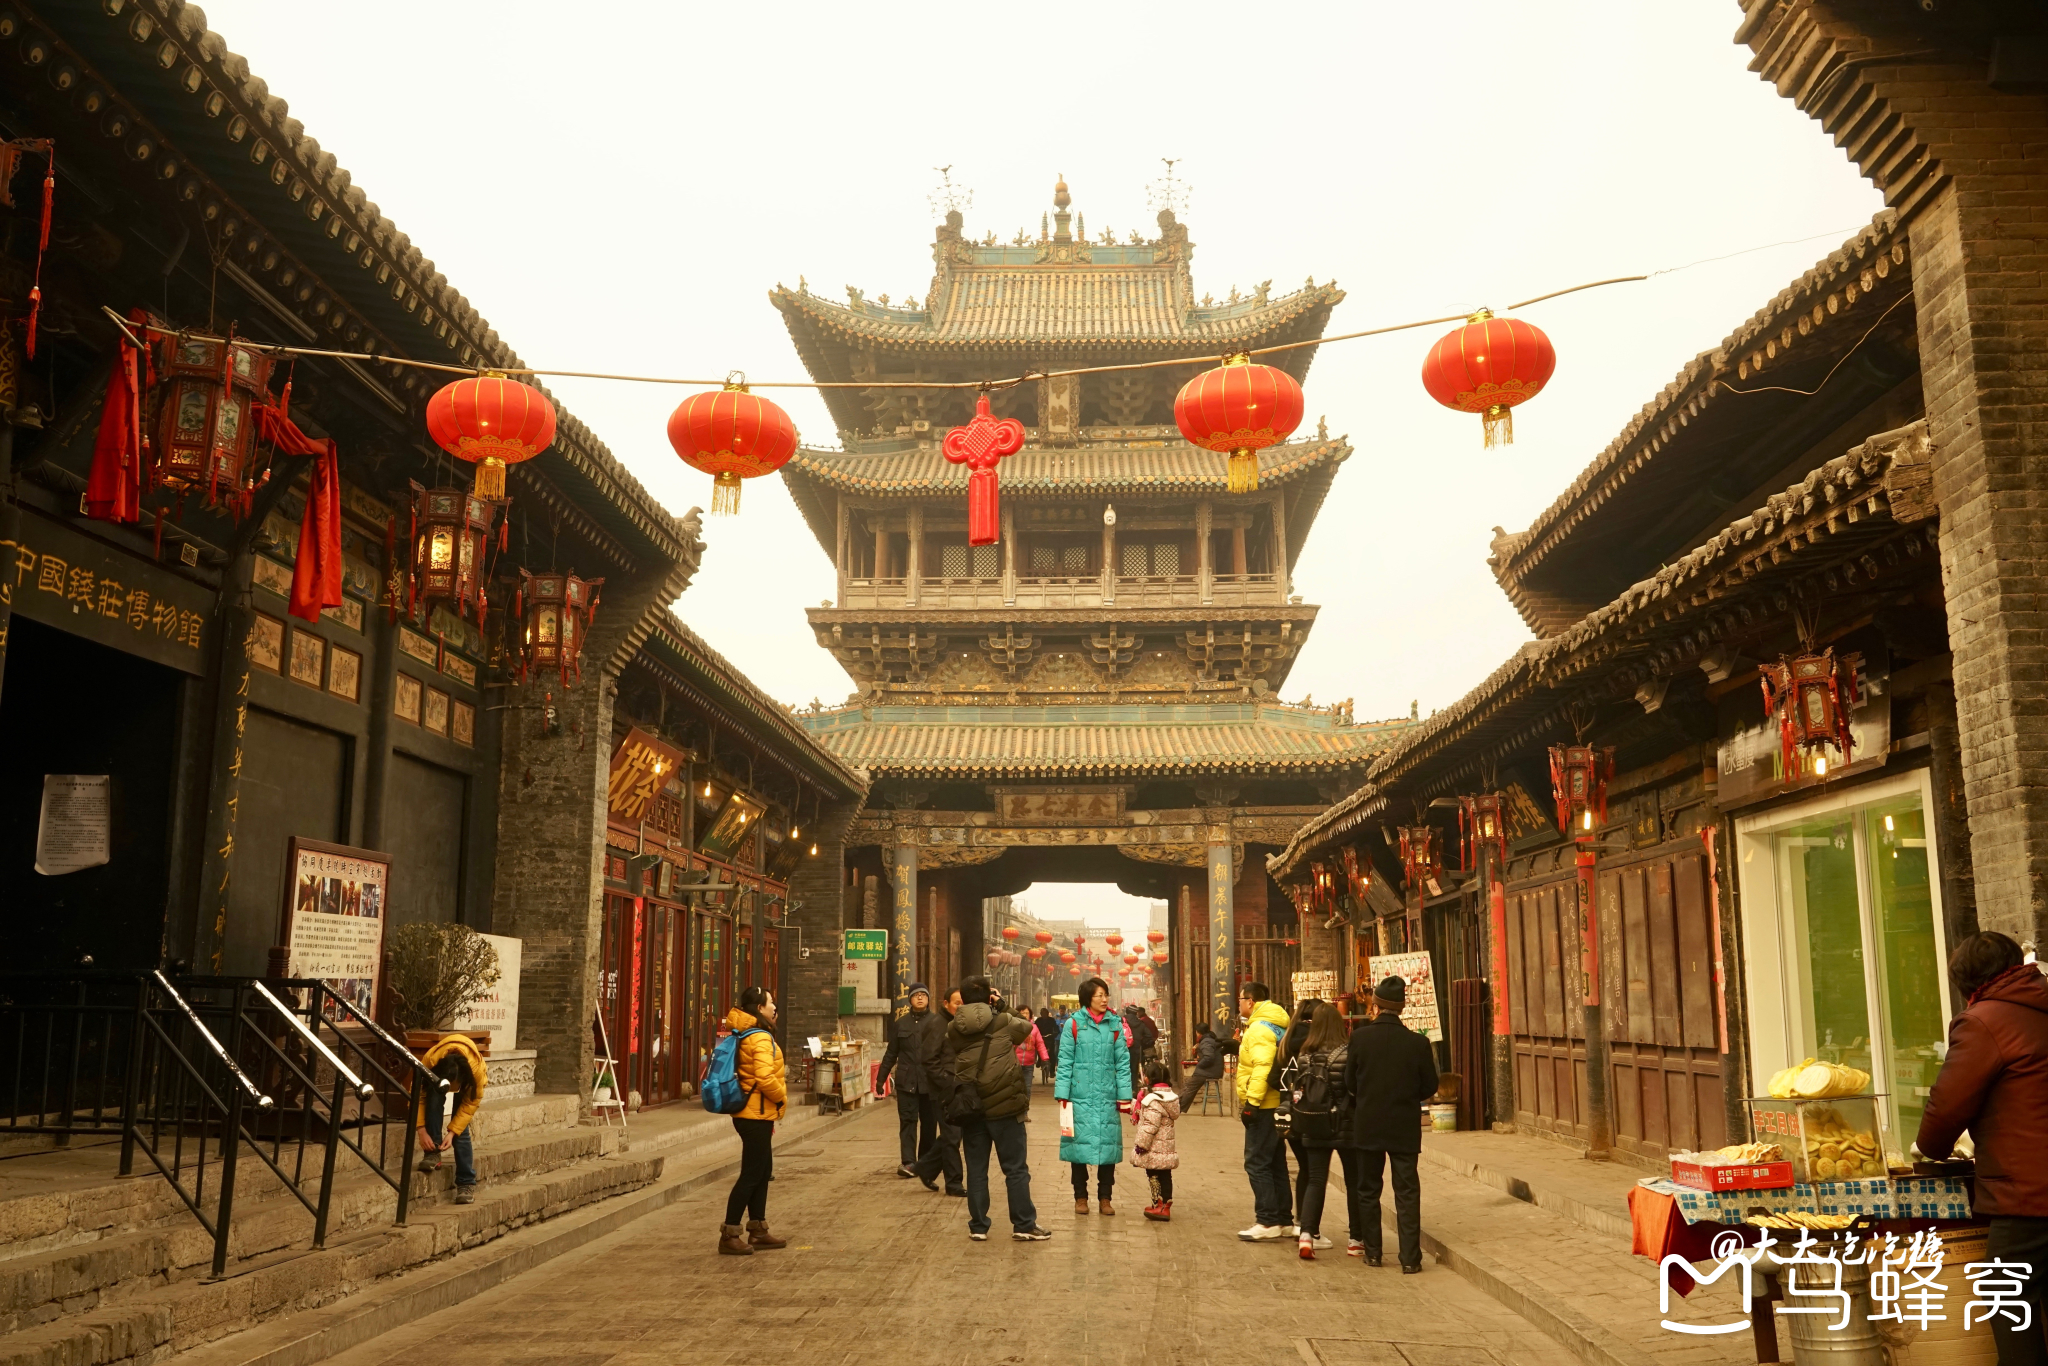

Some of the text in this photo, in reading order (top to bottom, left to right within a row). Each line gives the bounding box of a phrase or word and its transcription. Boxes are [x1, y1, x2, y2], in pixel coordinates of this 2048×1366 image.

[15, 544, 204, 649] 中國錢莊博物館
[847, 941, 883, 952] 邮政驿站
[1212, 863, 1231, 1026] 朝晨午夕街三市
[1753, 1109, 1801, 1138] 手工月饼
